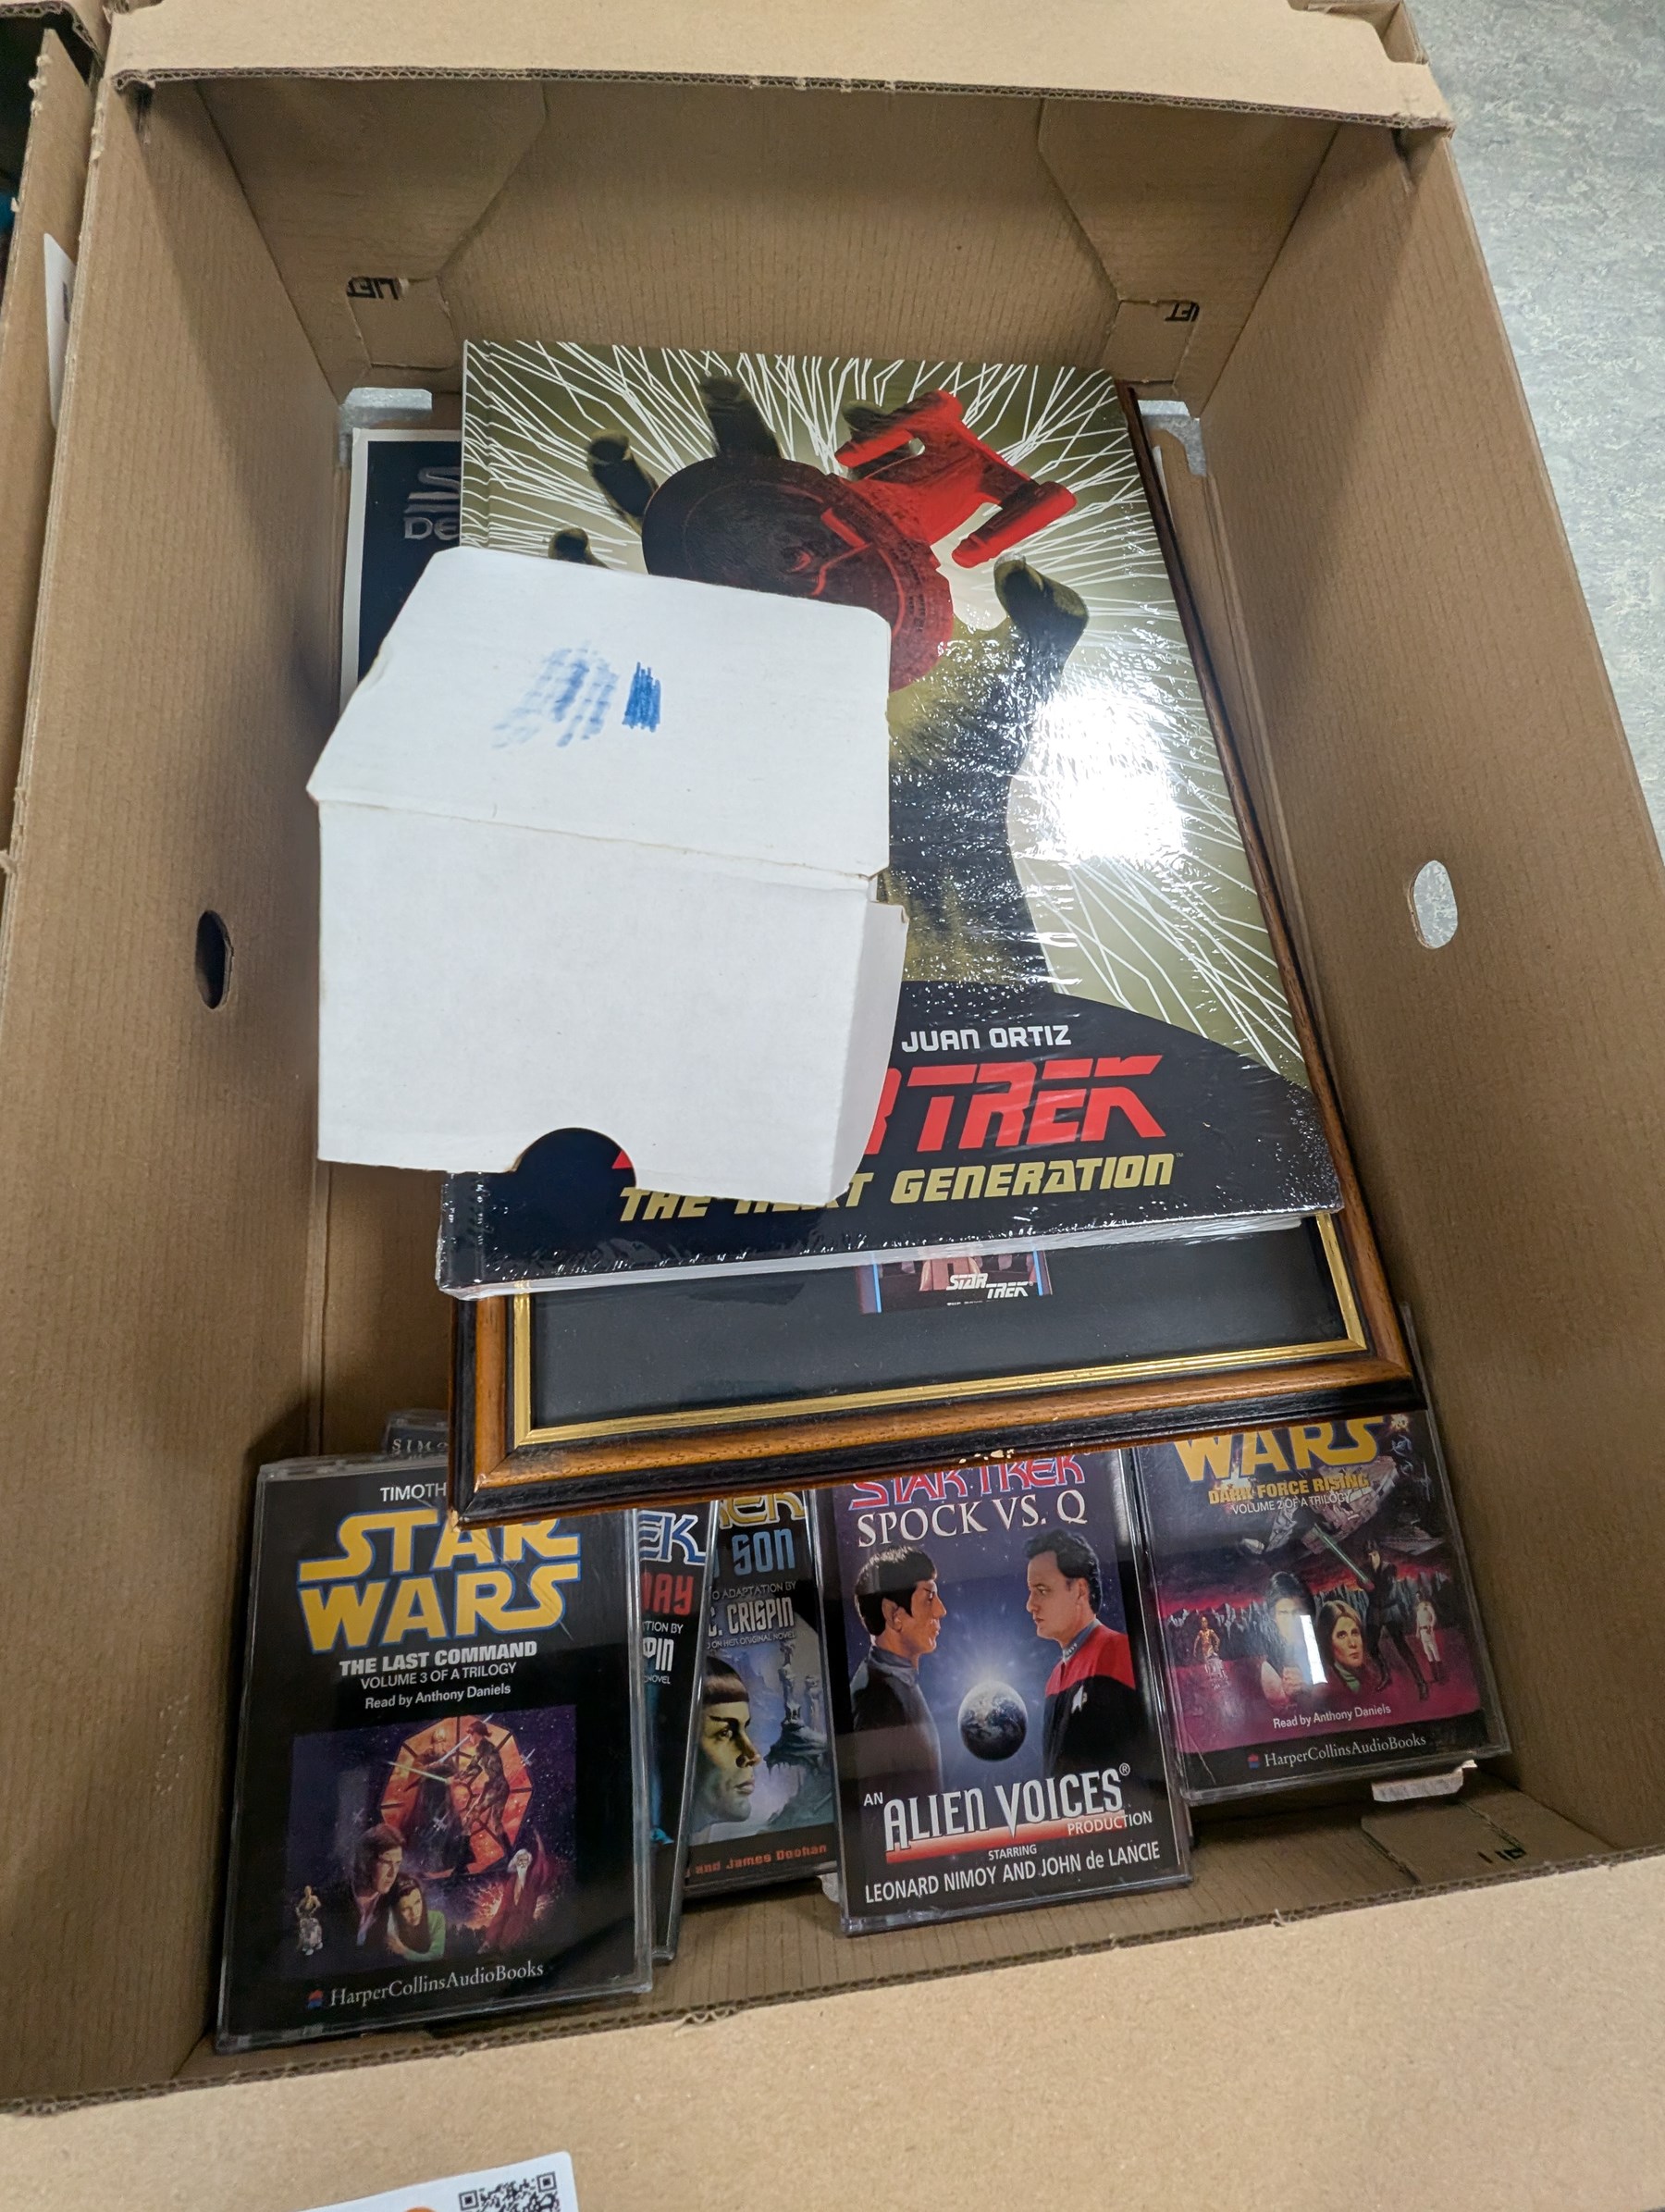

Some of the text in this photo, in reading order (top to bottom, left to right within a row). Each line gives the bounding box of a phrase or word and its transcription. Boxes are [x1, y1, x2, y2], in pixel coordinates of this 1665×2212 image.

[901, 1024, 1072, 1053] JUAN ORTIZ
[906, 1055, 1166, 1152] TREK
[946, 1273, 988, 1291] STAR
[986, 1281, 1029, 1299] TREK
[392, 1439, 448, 1453] SIMO
[1174, 1415, 1385, 1482] WARS
[380, 1482, 447, 1501] TIMOTH
[1208, 1473, 1370, 1504] DARK FORCE RISING
[1232, 1490, 1351, 1515] VOLUME 2 OF A TRILOGY
[857, 1489, 1089, 1548] SPOCK VS. Q
[298, 1509, 582, 1582] STAR
[732, 1528, 796, 1576] SON
[722, 1582, 783, 1599] ADAPTATION
[785, 1581, 796, 1590] BY
[298, 1561, 582, 1654] WARS
[727, 1597, 795, 1635] CRISPIN
[671, 1624, 684, 1635] BY
[741, 1635, 772, 1646] ORIGINAL
[339, 1641, 537, 1676] THE LAST COMMAND
[361, 1662, 517, 1690] VOLUME 3 OF A TRILOGY
[364, 1683, 512, 1709] Read by Anthony Daniels
[1273, 1703, 1392, 1729] Read by Anthony Daniels
[1264, 1733, 1426, 1768] HarperCollinsAudioBooks
[863, 1791, 884, 1807] AN
[883, 1787, 988, 1851] ALIEN
[1067, 1810, 1153, 1835] PRODUCTION
[696, 1860, 722, 1875] and
[725, 1853, 771, 1870] James
[776, 1844, 827, 1861] Doohan
[987, 1844, 1037, 1860] STARRING
[865, 1841, 1161, 1904] LEONARD NIMOY AND JOHN de LANCIE
[330, 1960, 545, 2008] HarperCollinsAudioBooks
